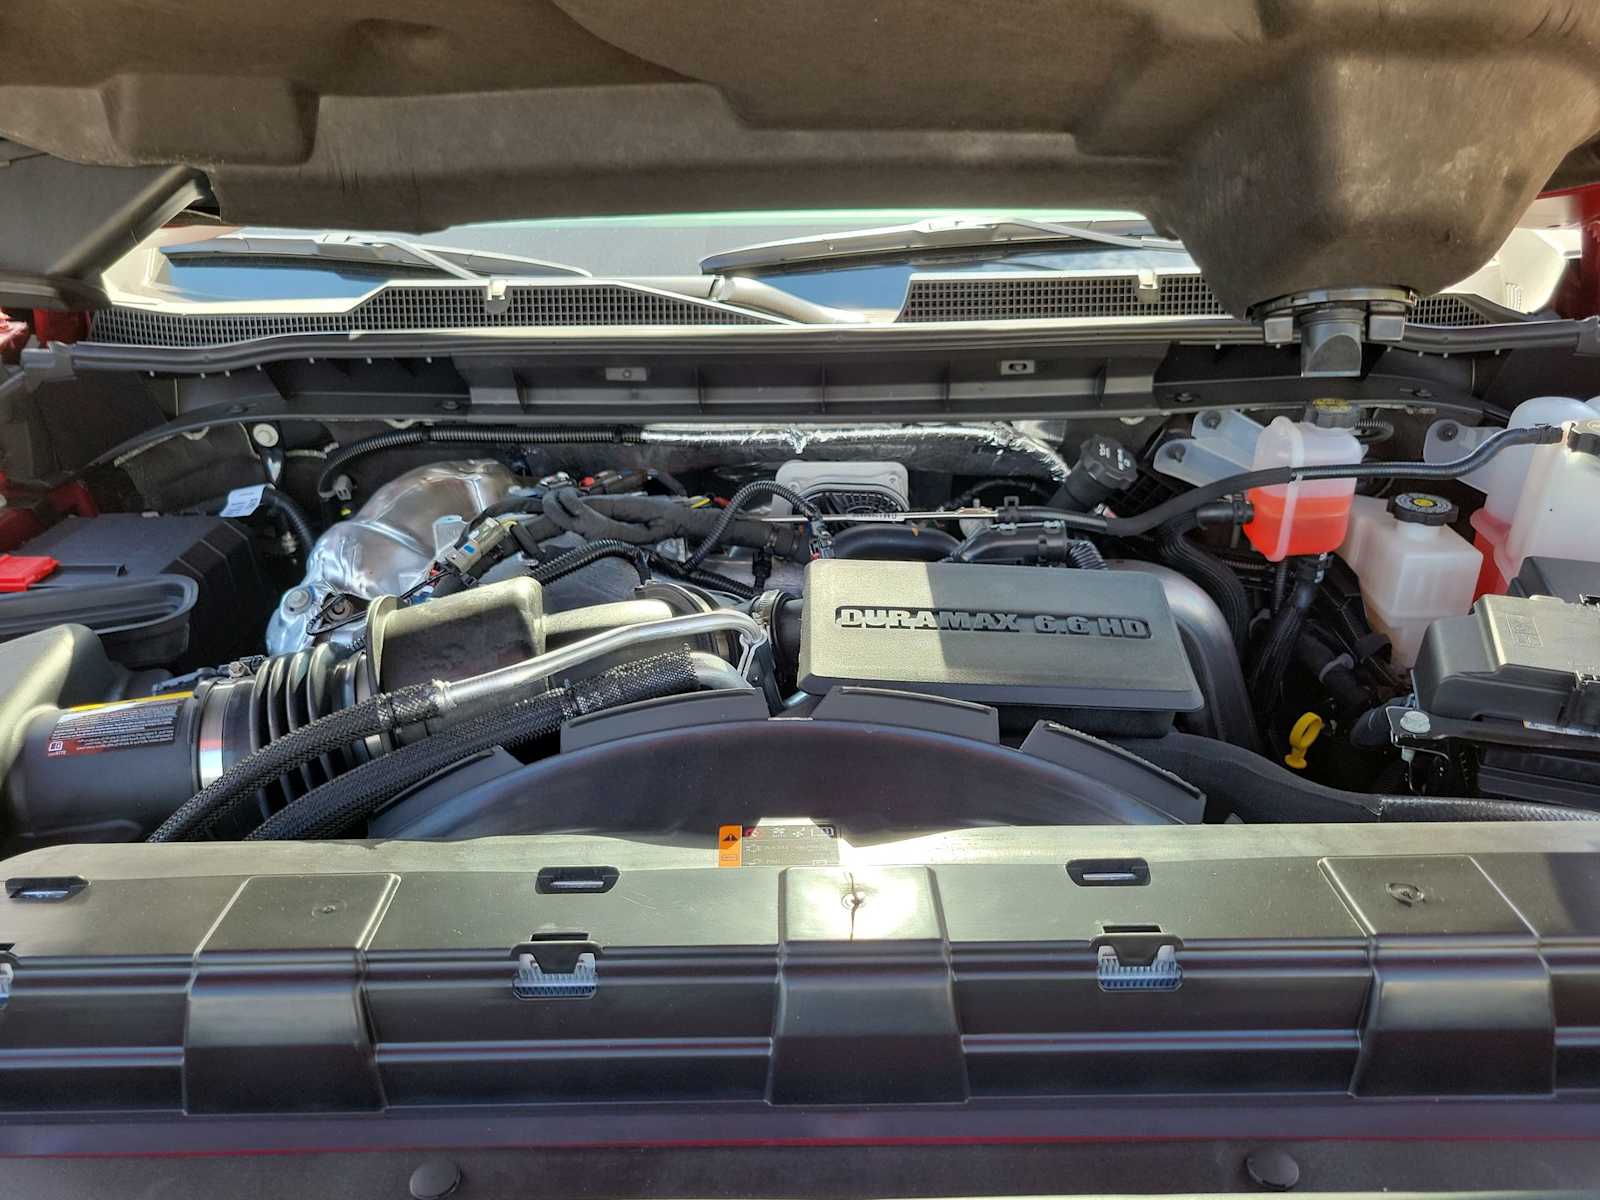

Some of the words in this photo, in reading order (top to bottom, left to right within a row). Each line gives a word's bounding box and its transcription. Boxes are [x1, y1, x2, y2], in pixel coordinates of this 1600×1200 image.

[841, 609, 1019, 632] DURAMAX
[1034, 614, 1091, 635] 6.6
[1097, 617, 1149, 637] HD
